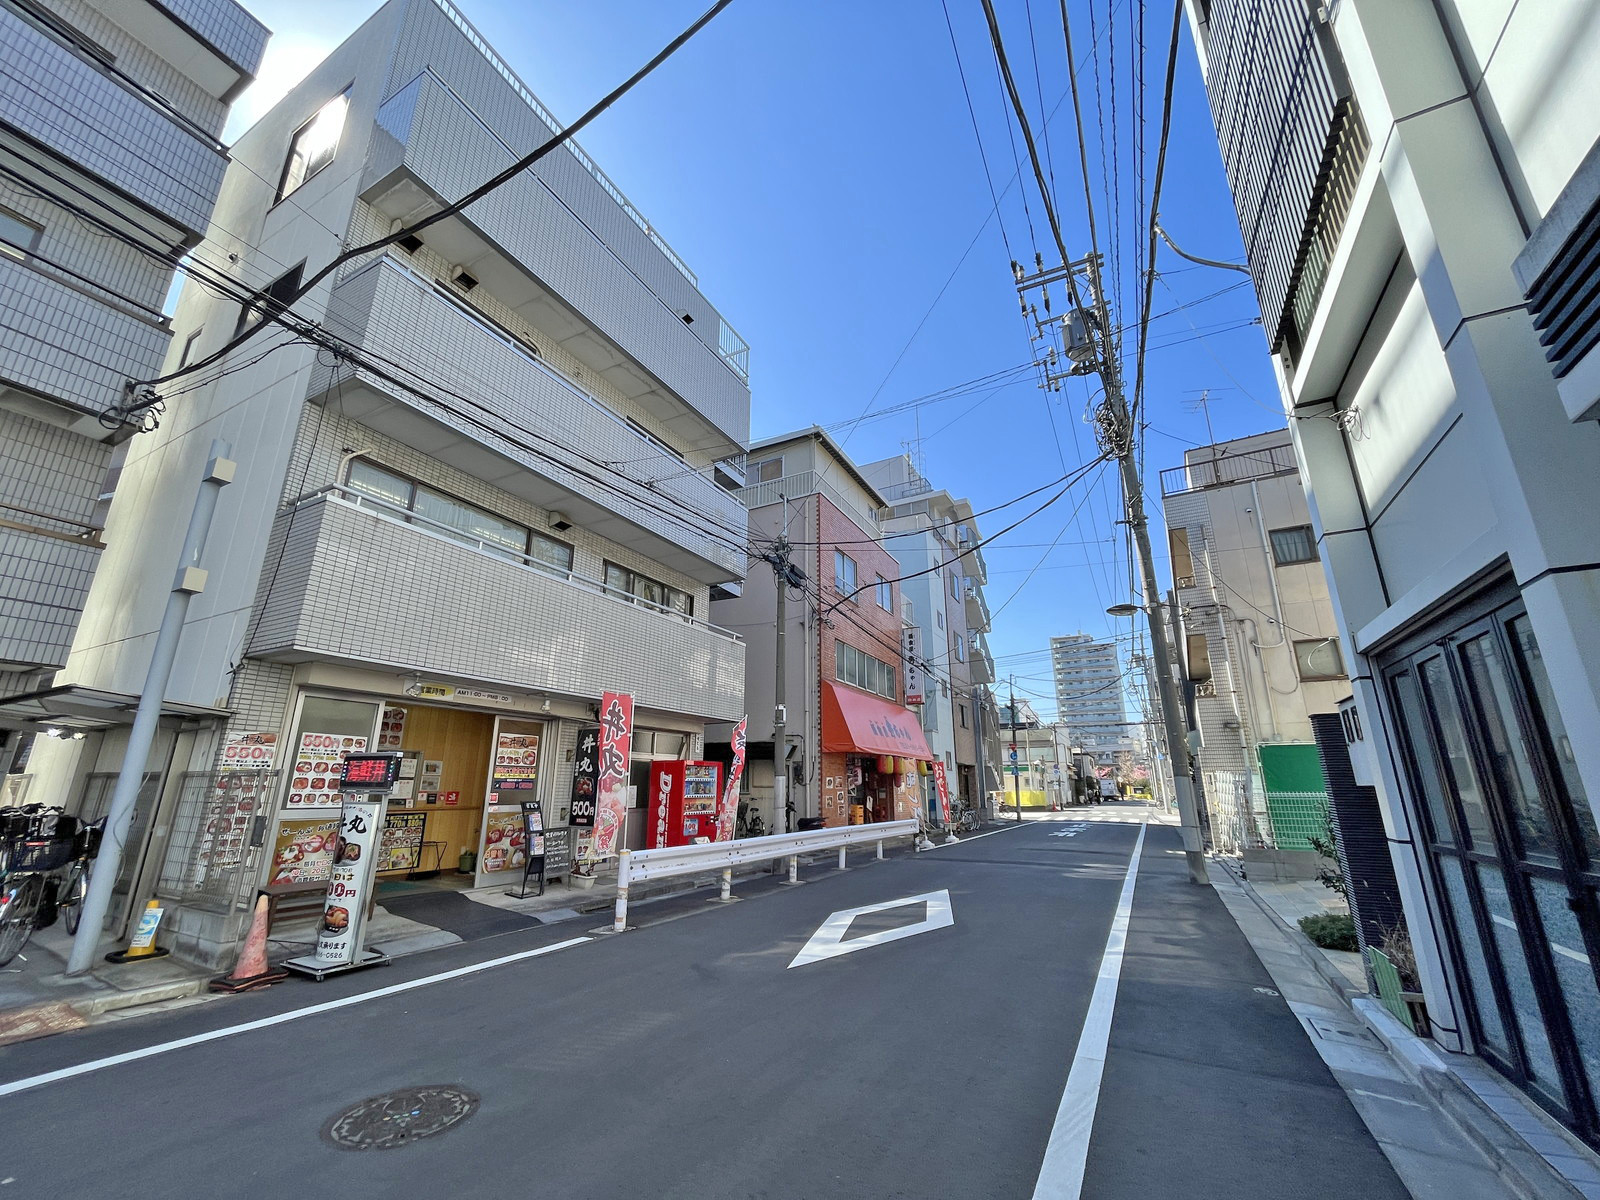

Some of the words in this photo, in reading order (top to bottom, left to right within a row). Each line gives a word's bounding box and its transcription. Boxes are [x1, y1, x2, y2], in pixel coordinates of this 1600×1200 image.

[303, 734, 340, 749] 550円
[225, 746, 274, 760] 550円
[572, 801, 594, 816] 500円
